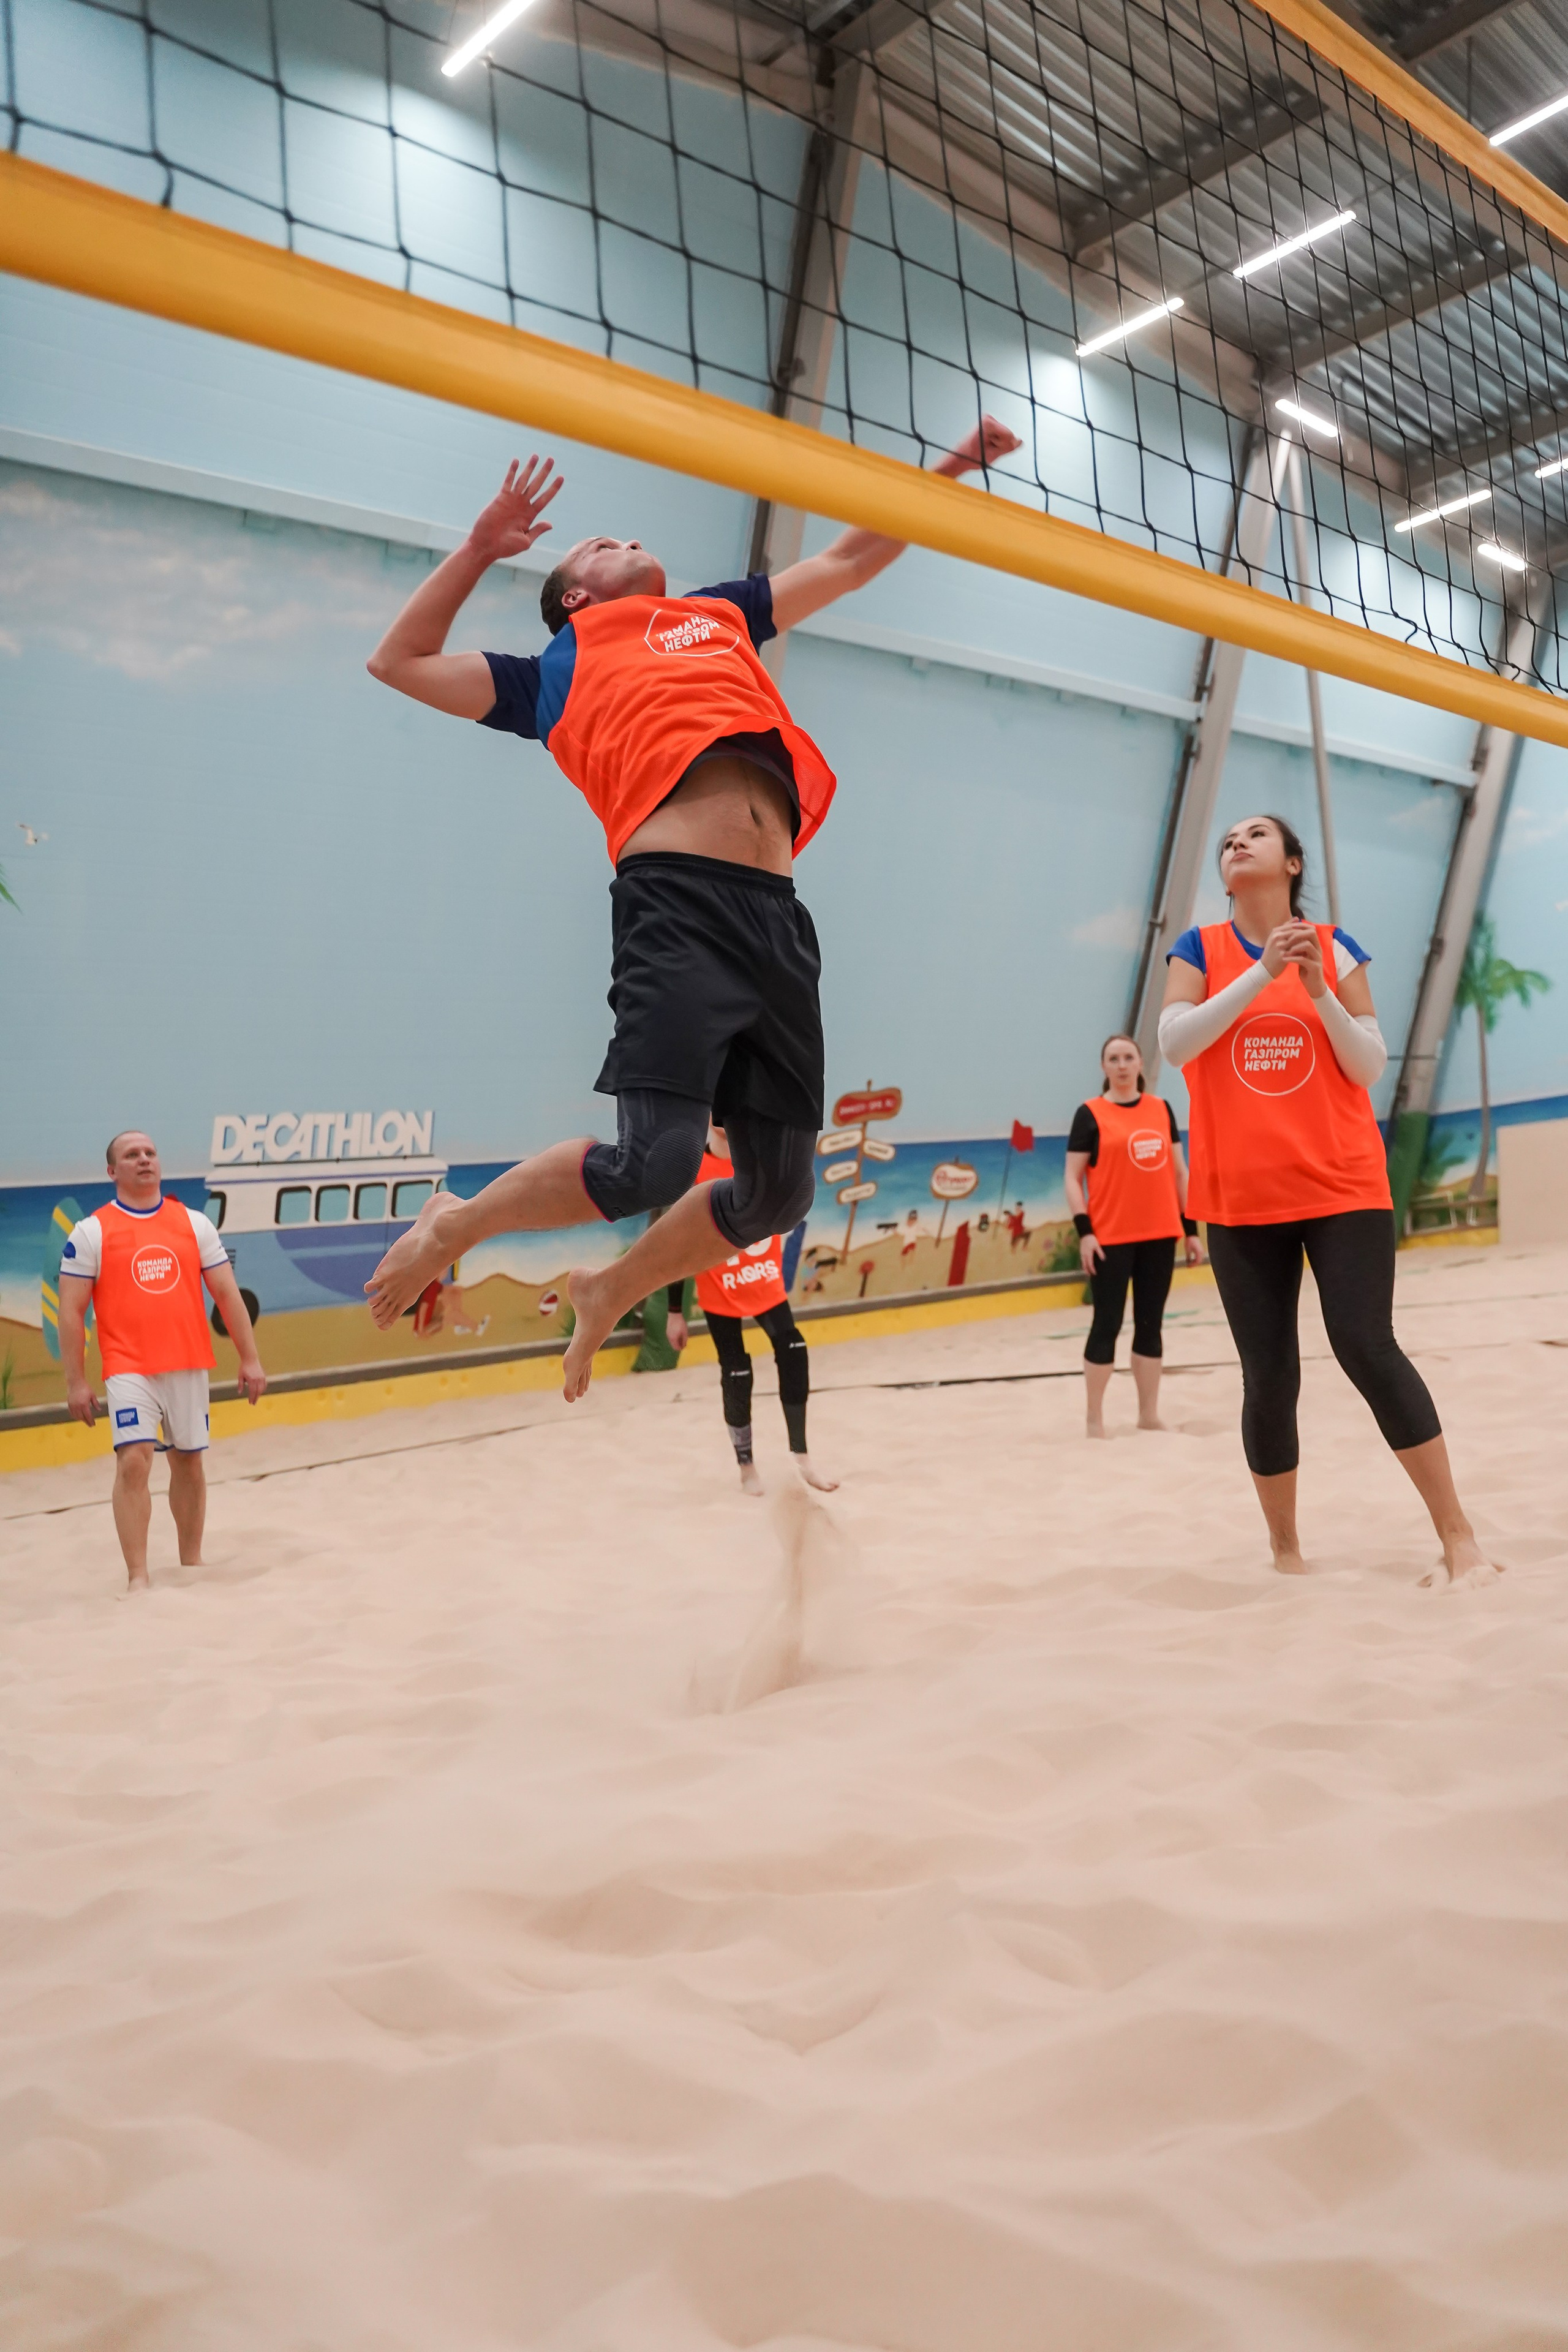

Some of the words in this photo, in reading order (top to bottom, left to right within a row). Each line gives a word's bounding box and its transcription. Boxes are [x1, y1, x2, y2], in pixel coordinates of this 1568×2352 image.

[664, 631, 710, 652] НЕФТИ
[1243, 1036, 1304, 1048] КОМАНДА
[1244, 1048, 1300, 1060] ГАЗПРОМ
[1244, 1060, 1287, 1071] НЕФТИ
[210, 1110, 435, 1163] DECATHLON
[137, 1257, 172, 1268] КОМАНДА
[139, 1264, 171, 1275] ГАЗПРОМ
[140, 1272, 165, 1281] НЕФТИ
